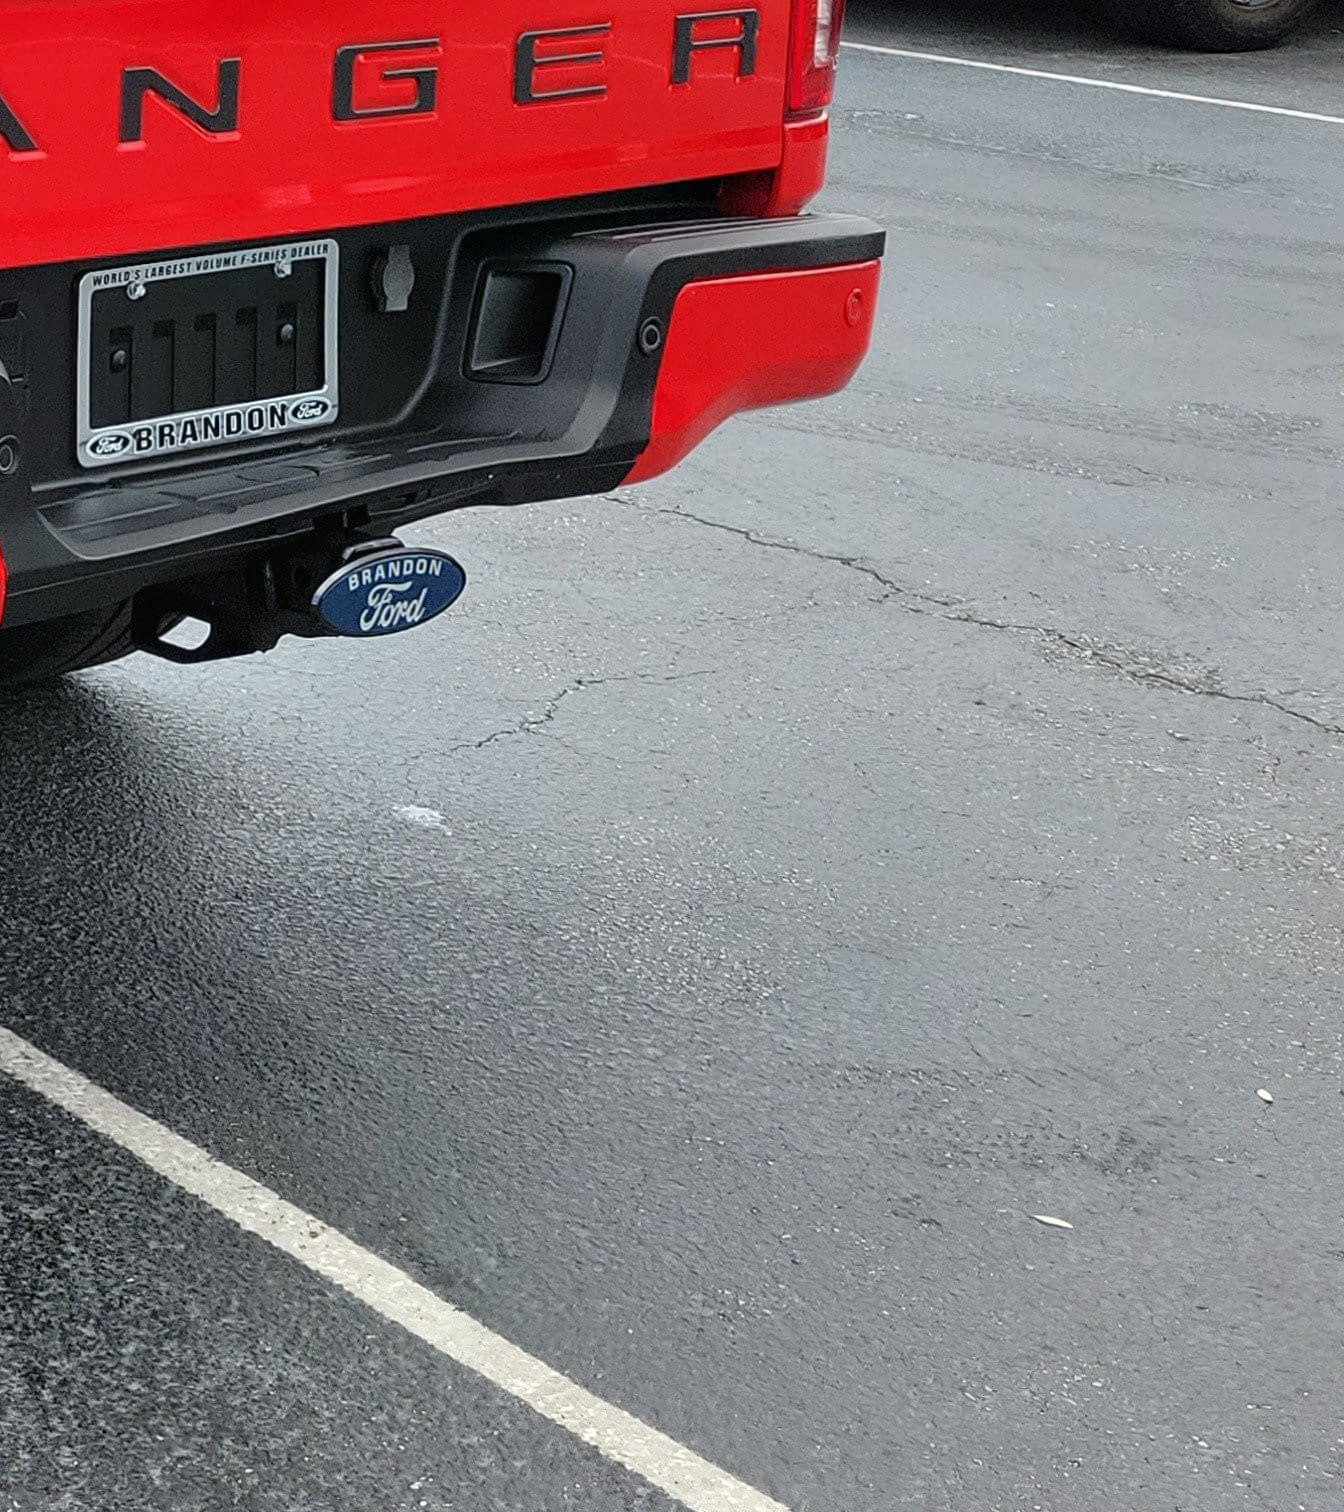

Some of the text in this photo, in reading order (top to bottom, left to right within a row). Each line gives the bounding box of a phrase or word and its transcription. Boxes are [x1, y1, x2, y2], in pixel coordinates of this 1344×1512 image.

[93, 244, 329, 286] WORLD'S LARGEST VOLUME F-SERIES DEALER
[96, 402, 323, 454] Ford BRANDON Ford
[348, 558, 443, 591] BRANDON
[360, 581, 428, 631] Ford
